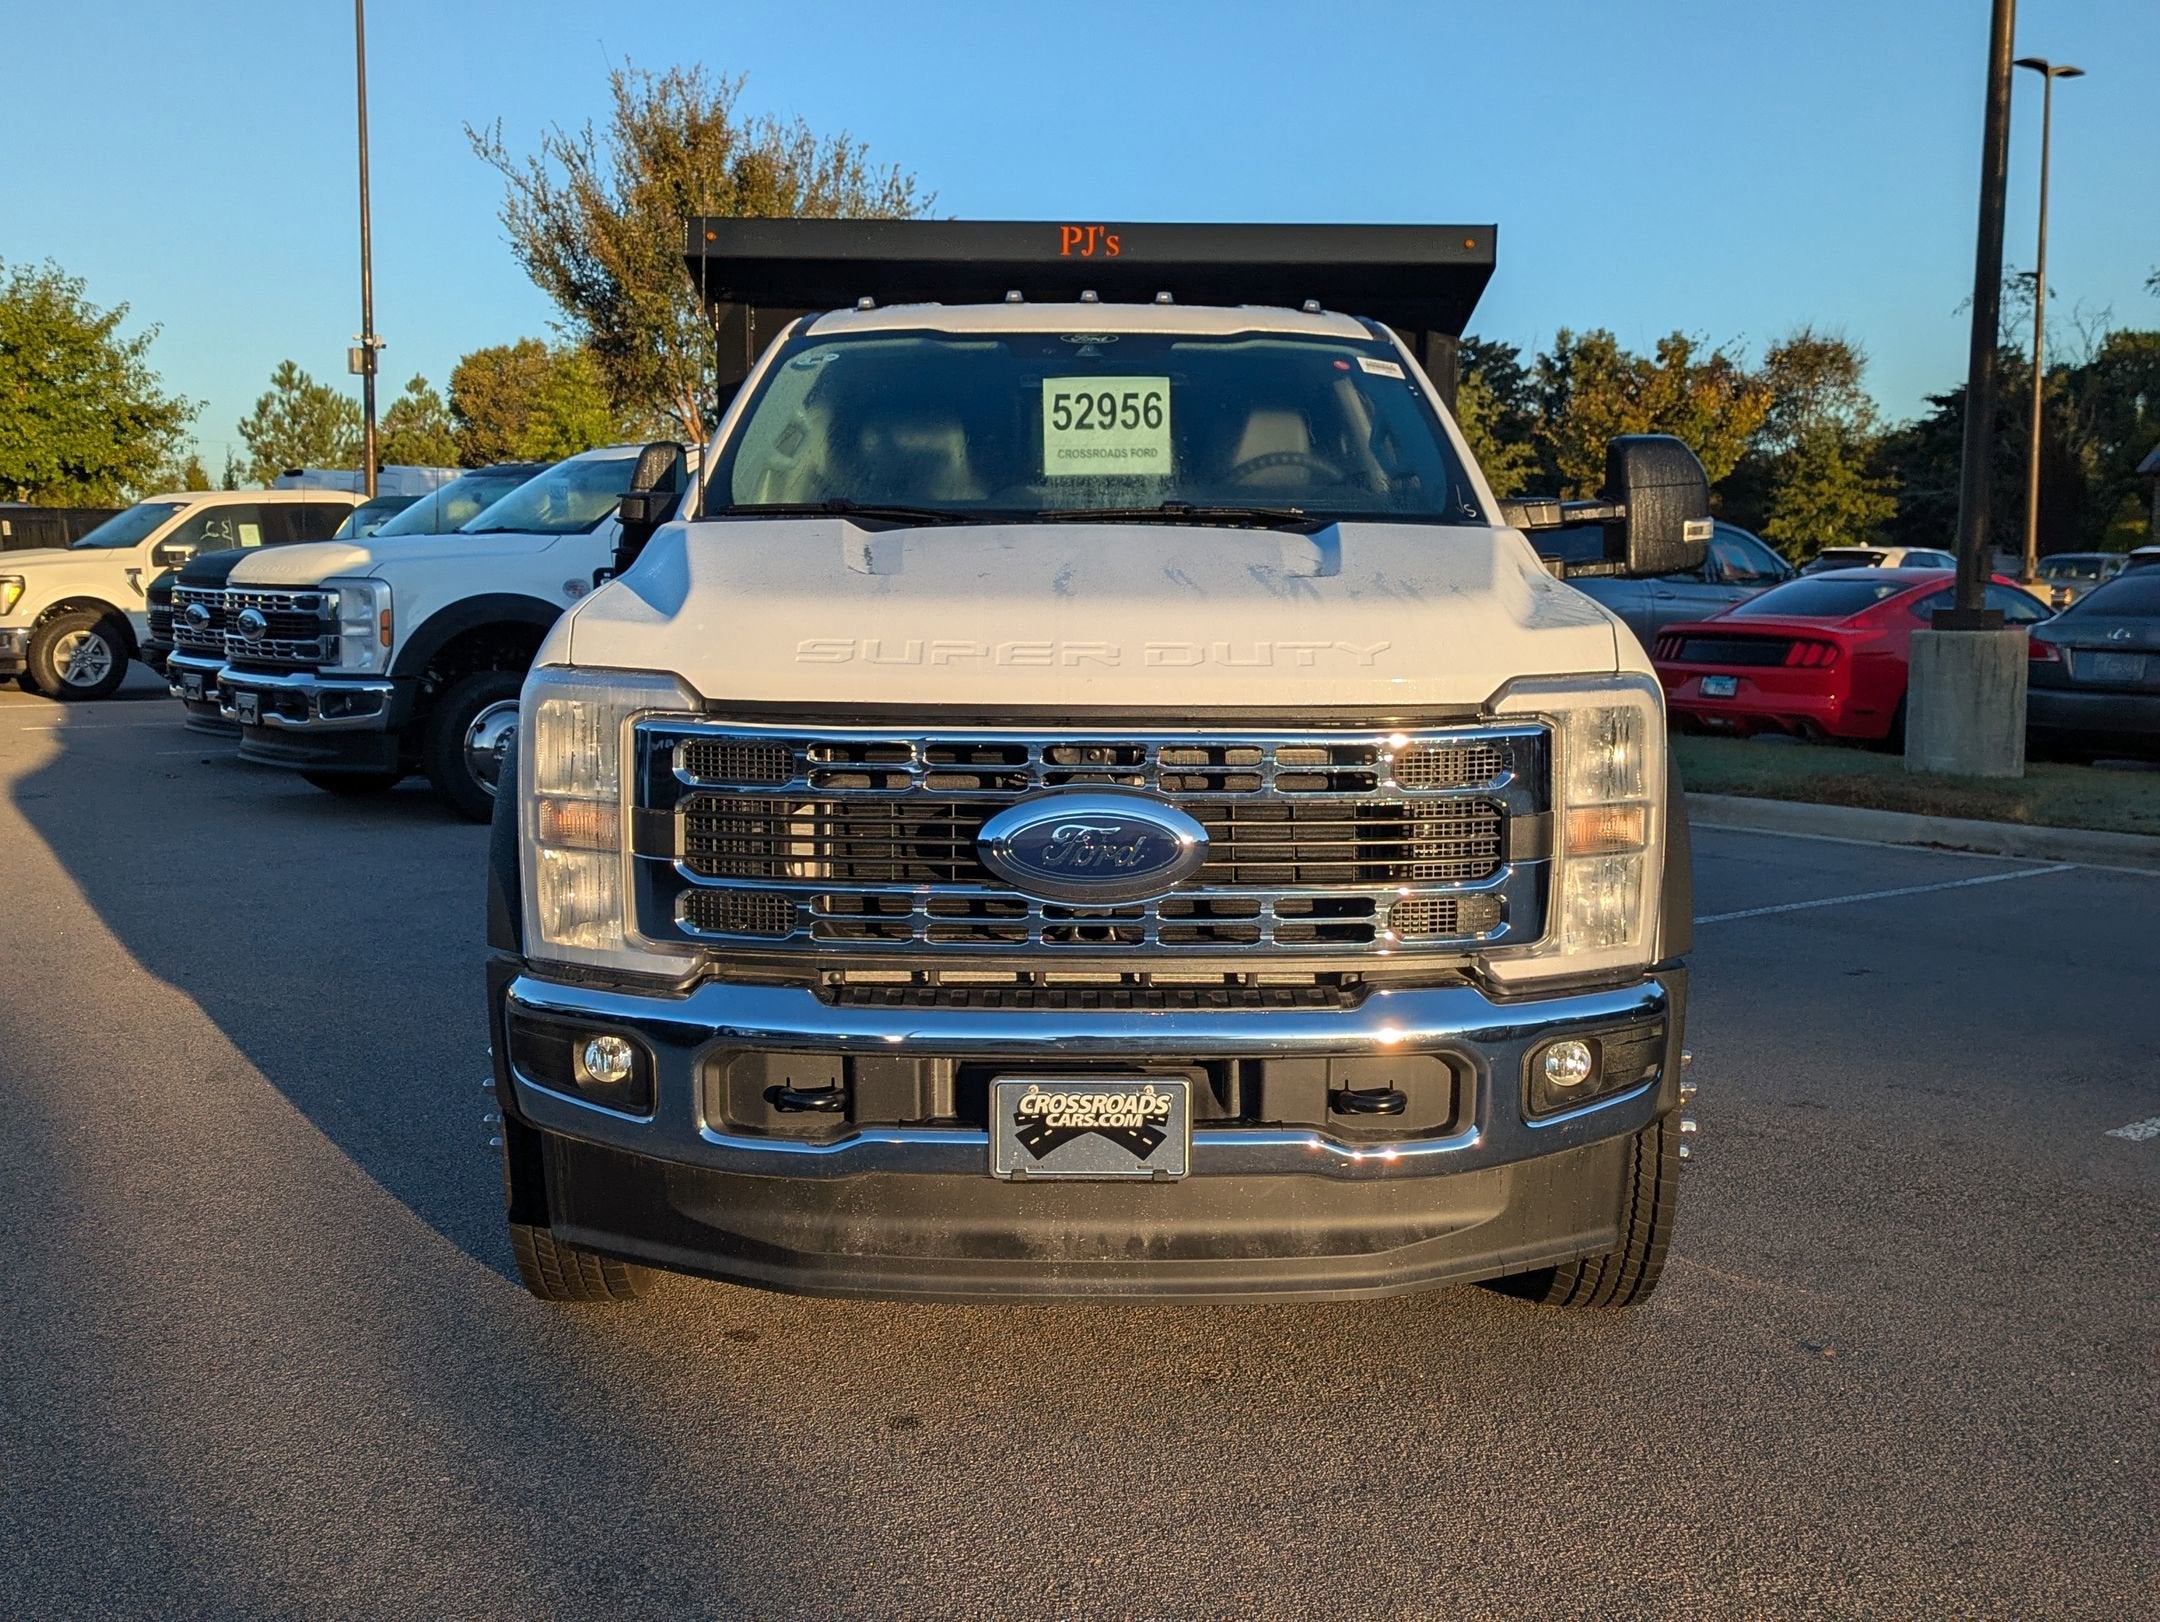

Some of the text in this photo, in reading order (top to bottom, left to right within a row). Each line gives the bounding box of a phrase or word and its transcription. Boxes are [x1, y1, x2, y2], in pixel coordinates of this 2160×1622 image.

[1060, 225, 1121, 257] PJ's
[1052, 392, 1163, 431] 52956
[1057, 447, 1158, 460] CROSSROADS FORD
[795, 638, 1392, 668] SUPER DUTY
[1041, 823, 1147, 868] Ford
[1018, 1093, 1172, 1115] CROSSROADS
[1045, 1113, 1144, 1128] CARS.COM
